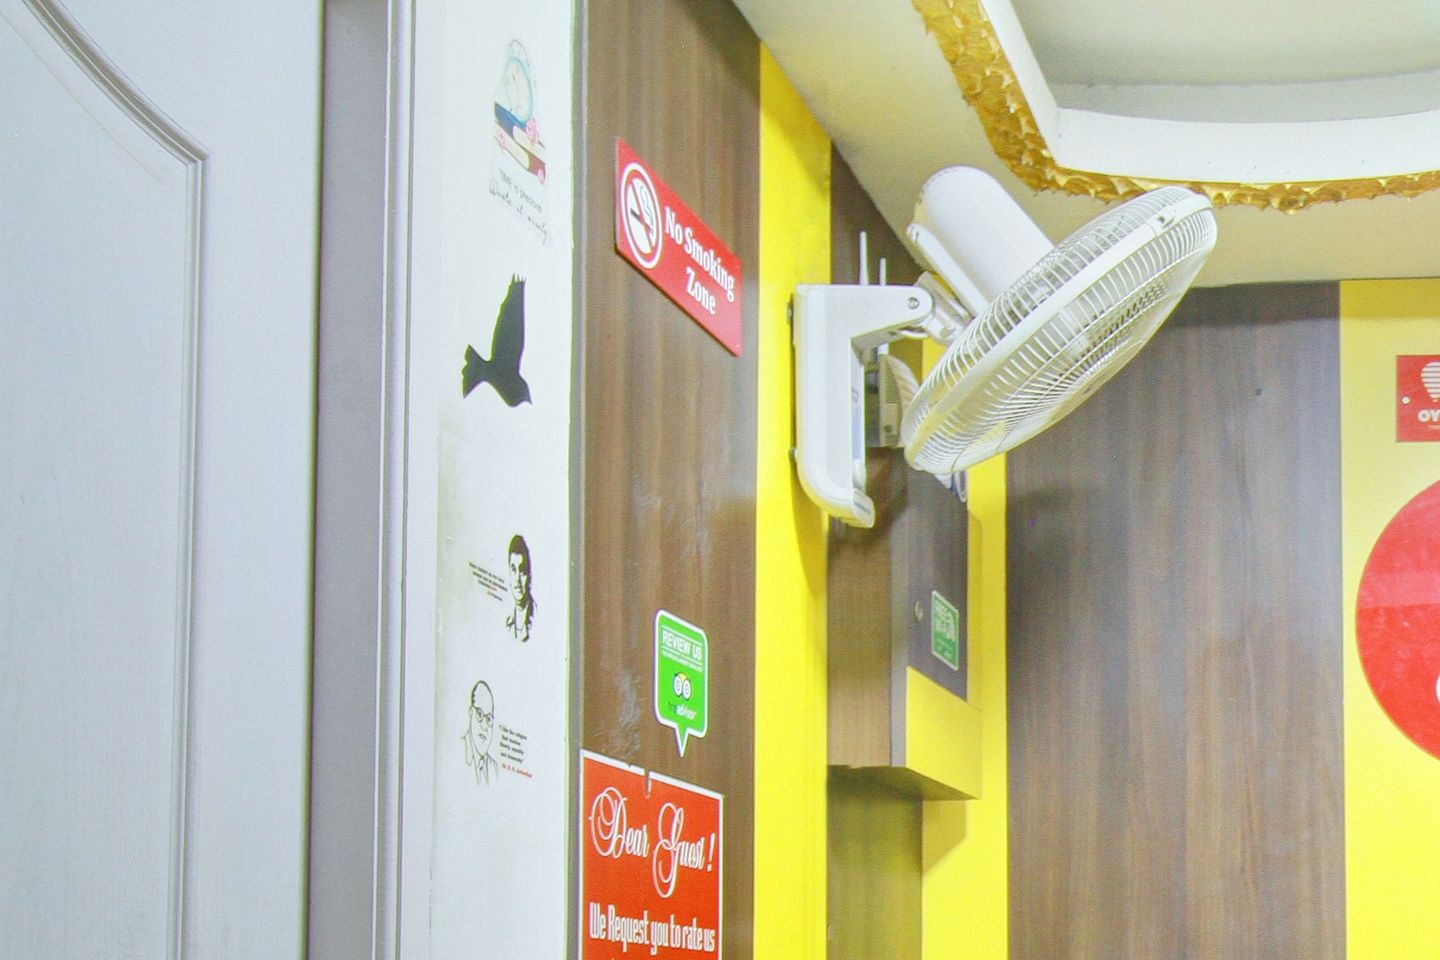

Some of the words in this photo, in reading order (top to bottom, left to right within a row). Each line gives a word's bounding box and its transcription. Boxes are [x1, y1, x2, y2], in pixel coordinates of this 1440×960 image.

[664, 206, 683, 245] No
[684, 226, 735, 302] Smoking
[685, 266, 716, 315] Zone
[589, 786, 649, 858] Dear
[653, 803, 705, 898] Guest
[707, 833, 715, 872] !
[590, 902, 606, 938] We
[607, 904, 649, 953] Request
[650, 921, 669, 956] you
[670, 914, 682, 948] to
[682, 917, 703, 951] rate
[703, 928, 715, 952] us
